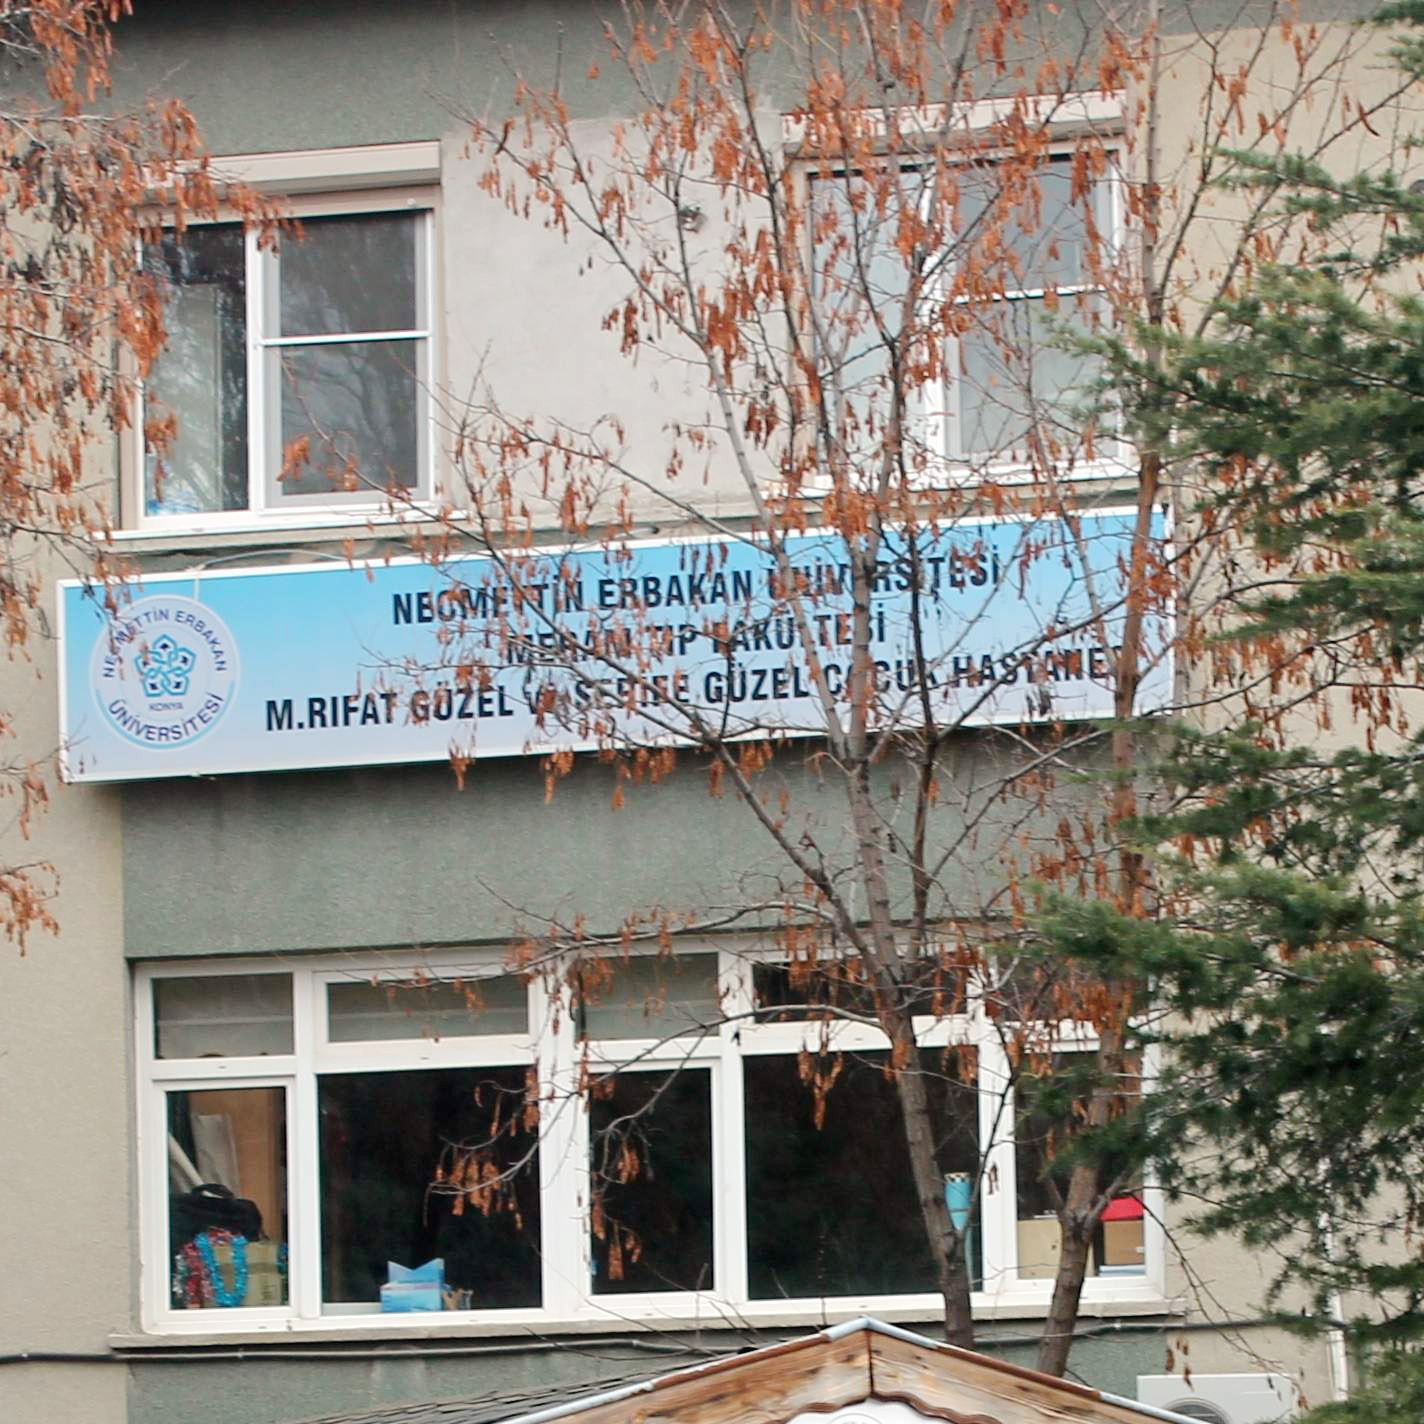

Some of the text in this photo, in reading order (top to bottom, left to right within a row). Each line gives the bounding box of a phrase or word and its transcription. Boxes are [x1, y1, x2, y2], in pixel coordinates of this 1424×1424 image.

[393, 545, 999, 625] NECMETİN ERBAKAN İVRSTESİ
[103, 606, 228, 678] NEMETTİN ERBAKAN
[713, 602, 884, 653] AKÜTEİ
[266, 692, 397, 731] M.RIFAT
[410, 681, 514, 721] GÜZEL
[704, 663, 810, 703] GÜZEL
[953, 645, 1123, 688] HASTANE
